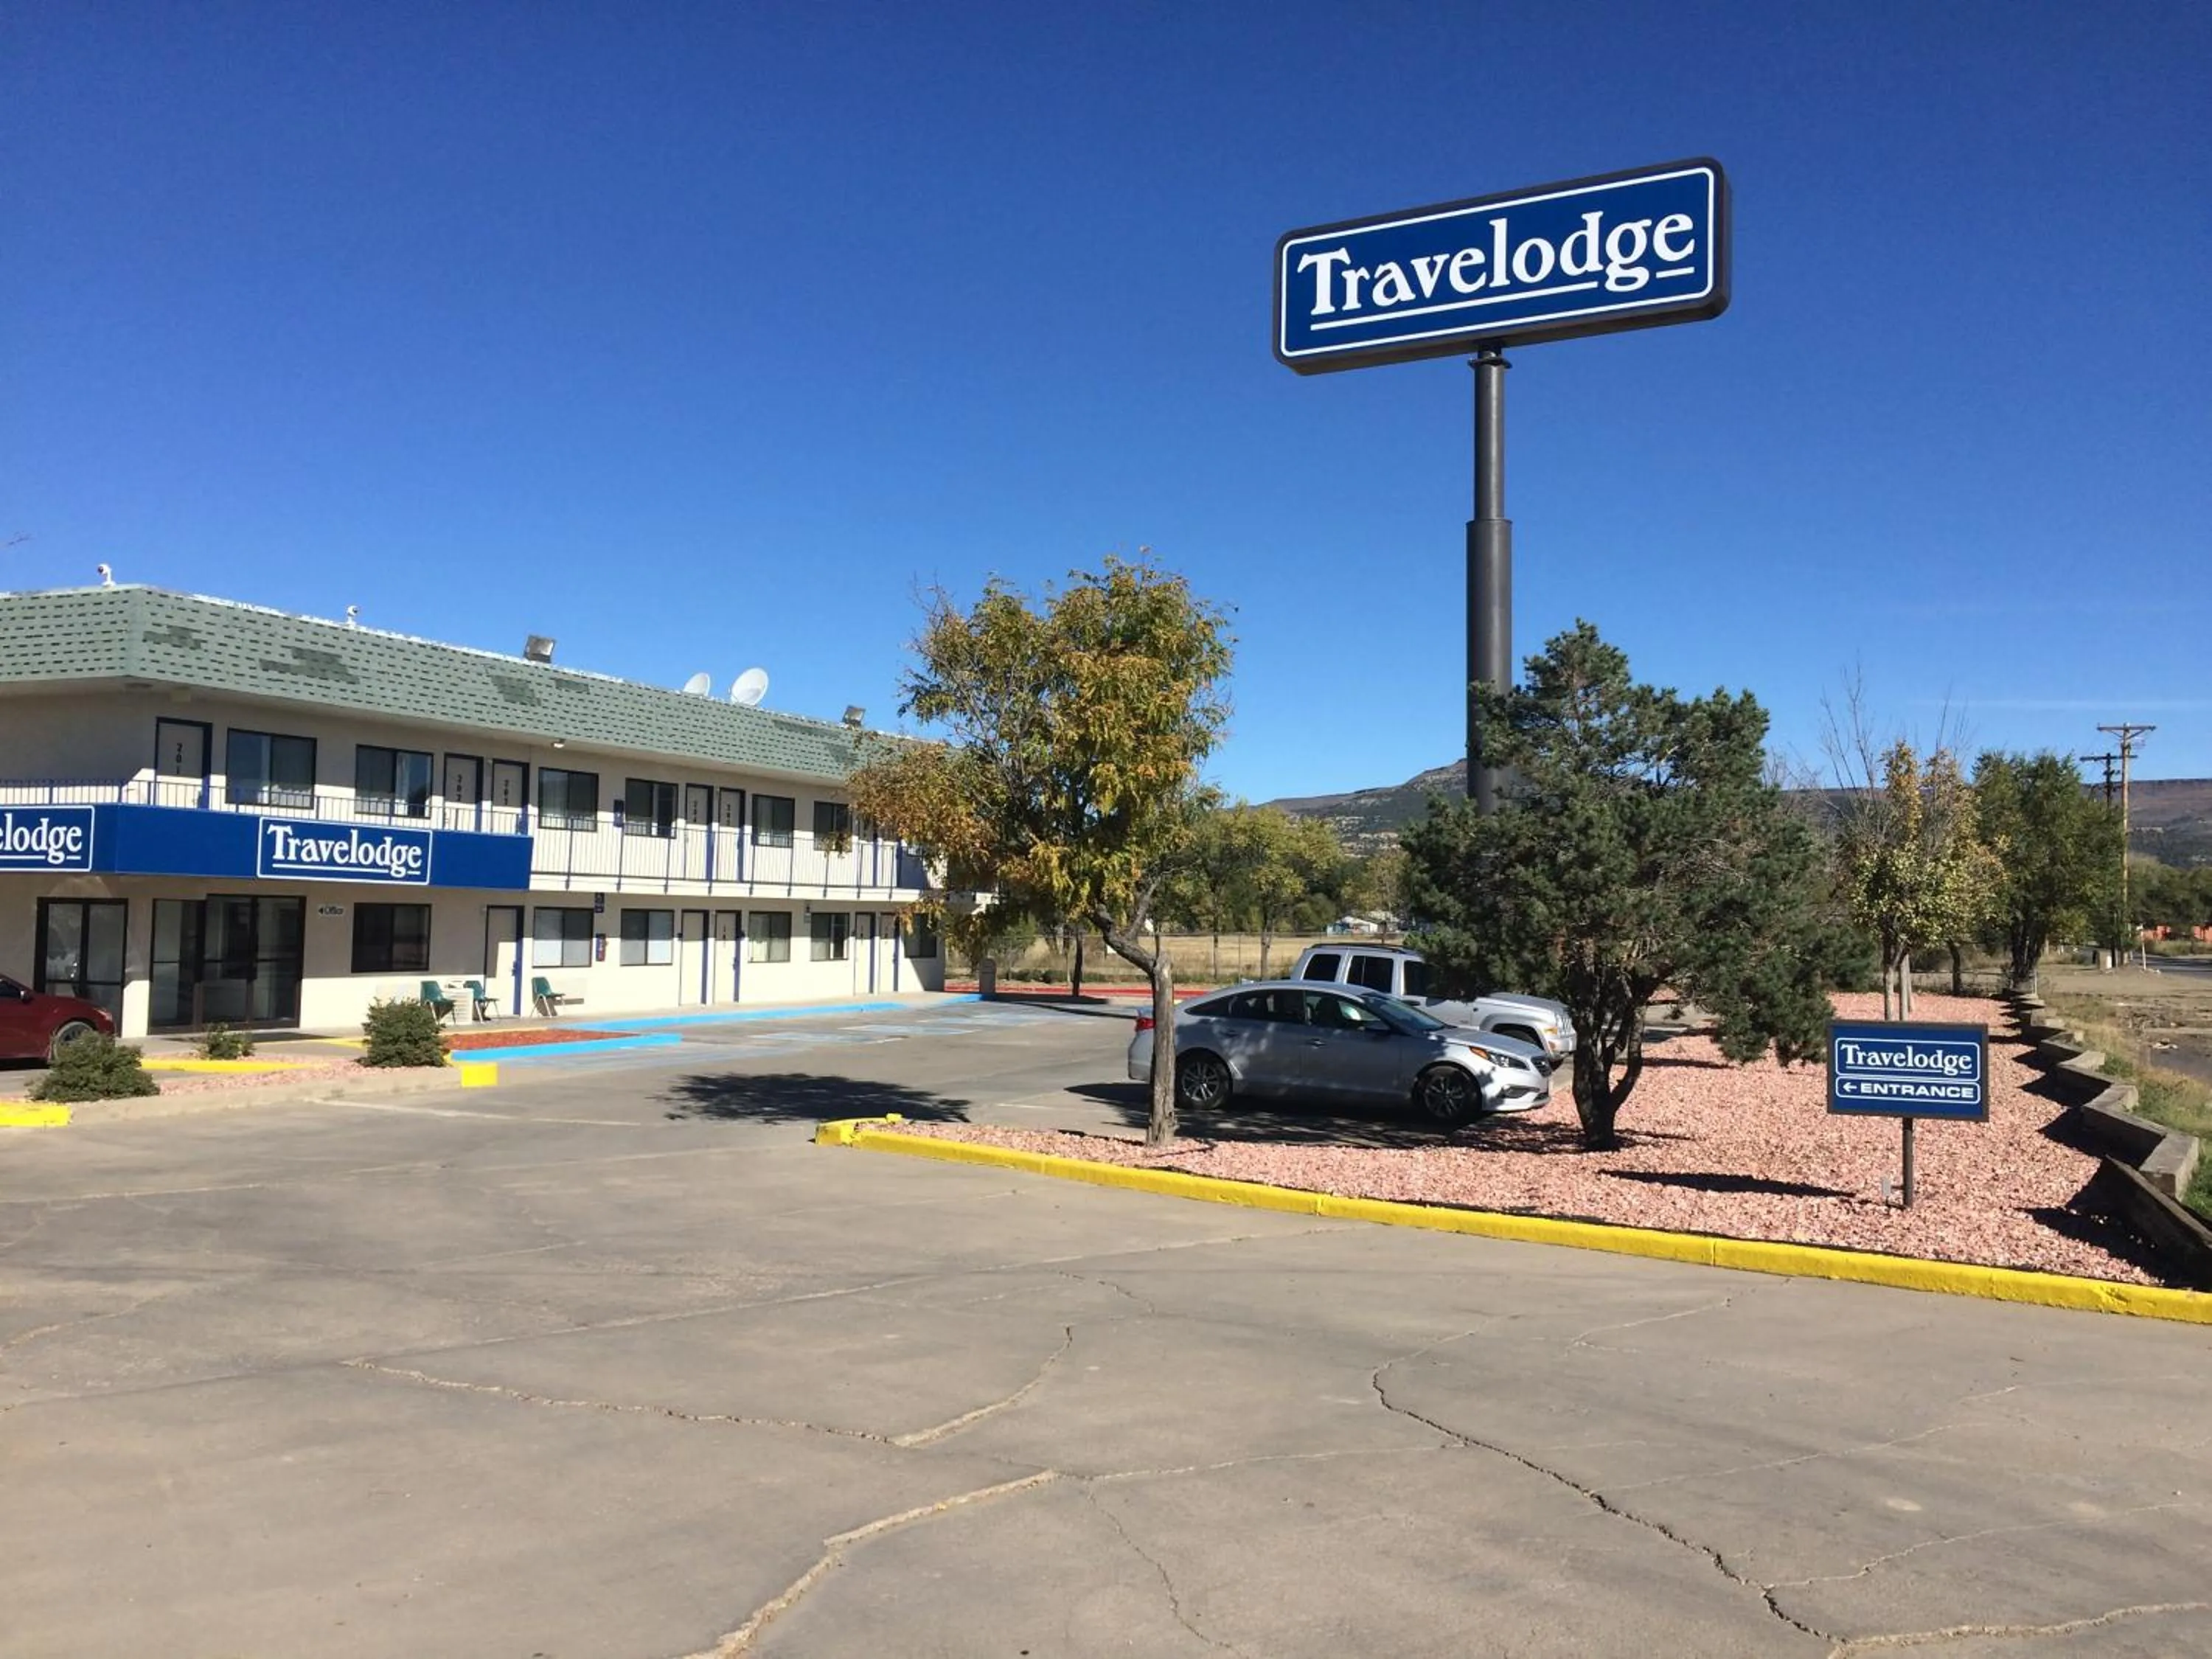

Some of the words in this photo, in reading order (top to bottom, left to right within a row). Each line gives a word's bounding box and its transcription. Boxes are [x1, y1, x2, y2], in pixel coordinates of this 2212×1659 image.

[1297, 211, 1694, 316] Travelodge
[0, 813, 82, 865] lodge
[267, 824, 422, 877] Travelodge
[1840, 1043, 1972, 1076] Travelodge
[1860, 1082, 1974, 1098] ENTRANCE
